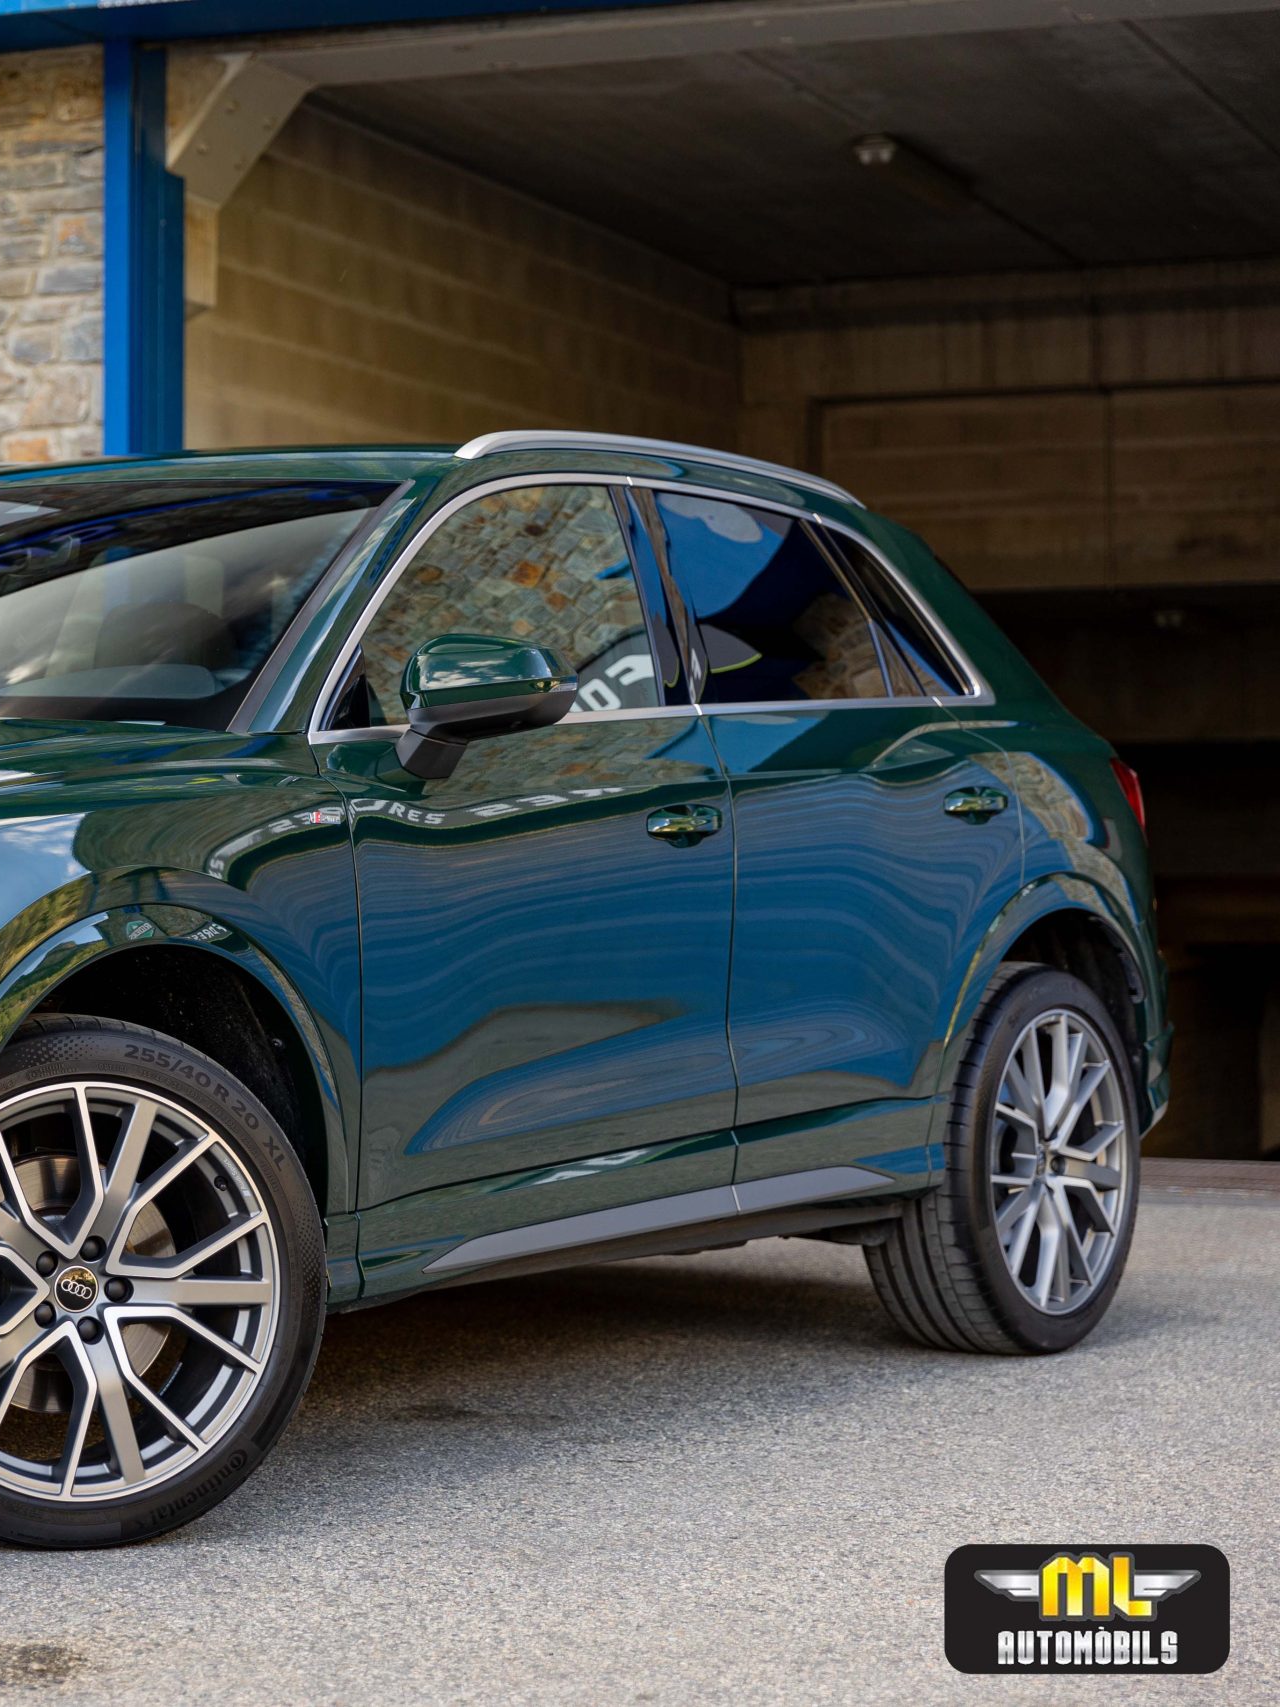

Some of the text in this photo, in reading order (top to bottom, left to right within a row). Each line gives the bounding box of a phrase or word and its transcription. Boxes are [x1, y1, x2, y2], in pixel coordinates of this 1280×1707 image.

[124, 1043, 211, 1088] 255/40
[213, 1082, 231, 1103] R
[231, 1101, 260, 1130] 20
[262, 1135, 289, 1172] XL
[150, 1449, 248, 1526] Continental
